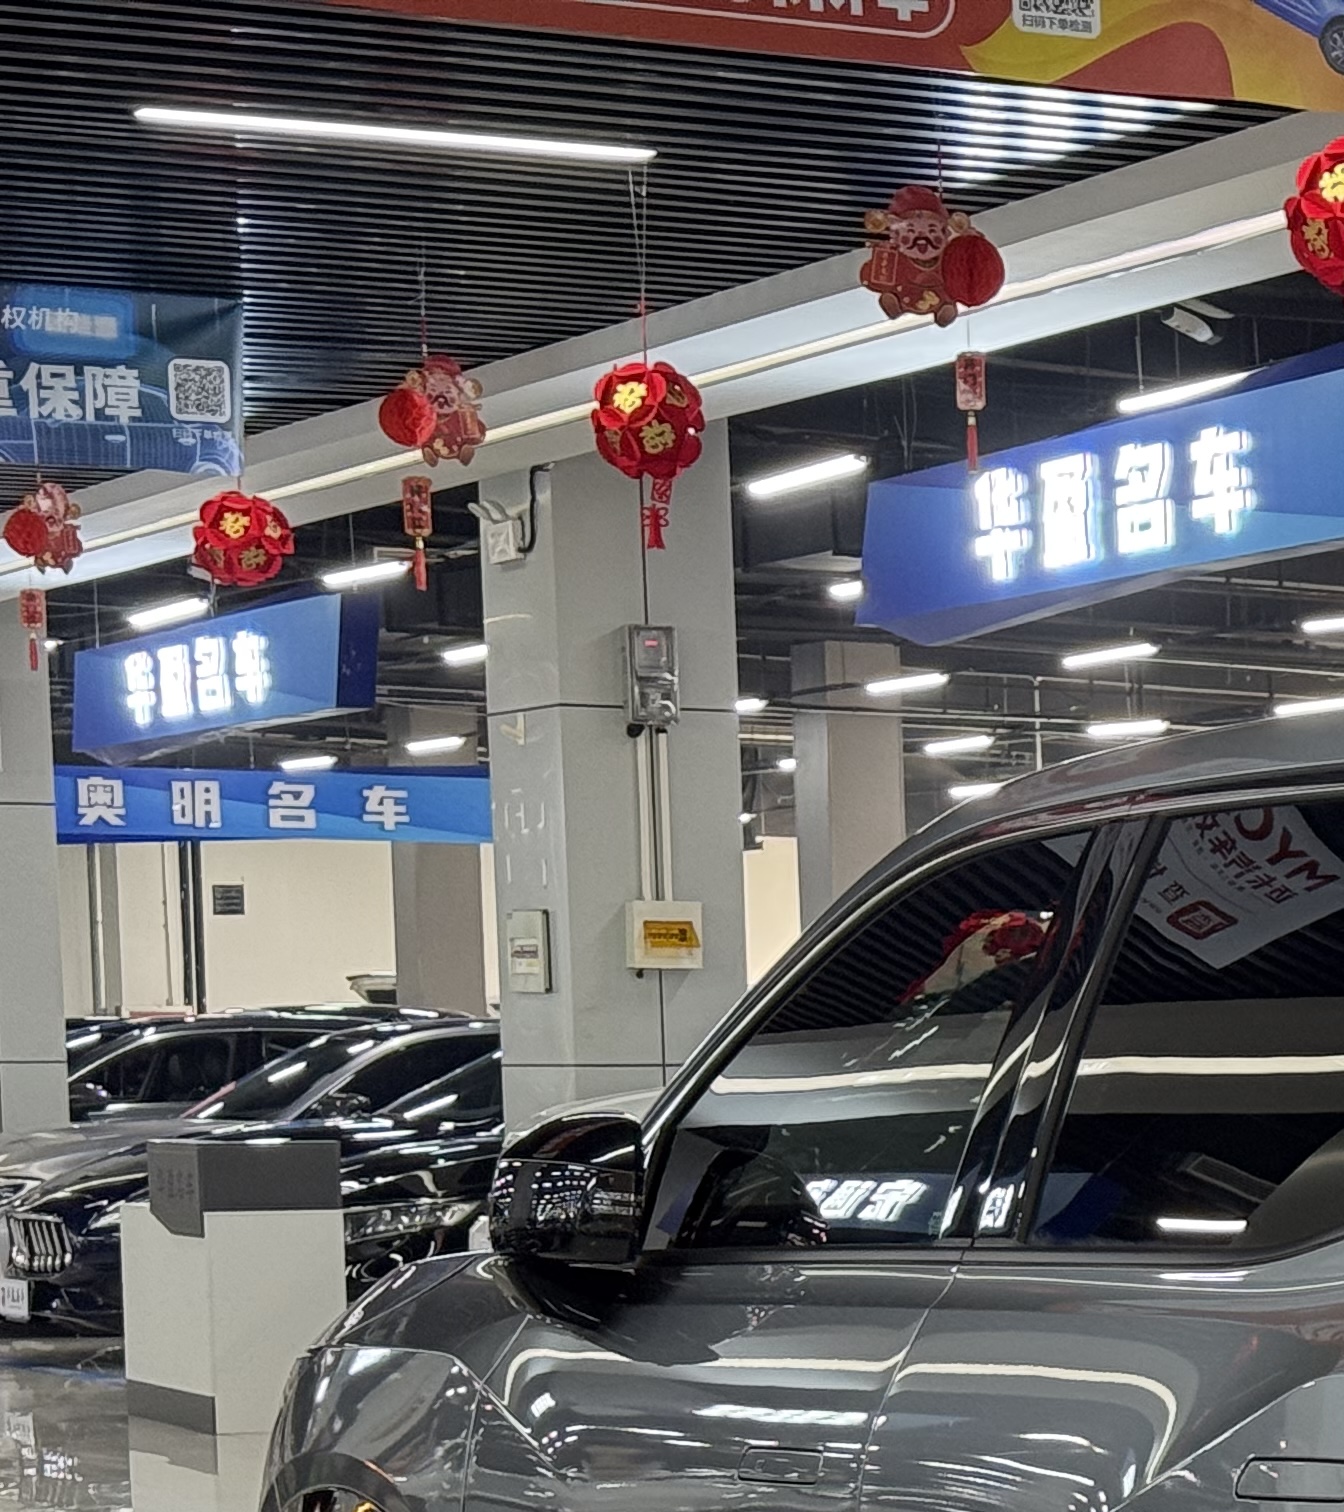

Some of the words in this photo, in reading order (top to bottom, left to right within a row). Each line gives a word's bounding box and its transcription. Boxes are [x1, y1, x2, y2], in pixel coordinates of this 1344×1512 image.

[0, 360, 142, 425] 保障
[77, 776, 411, 831] 奥明名车
